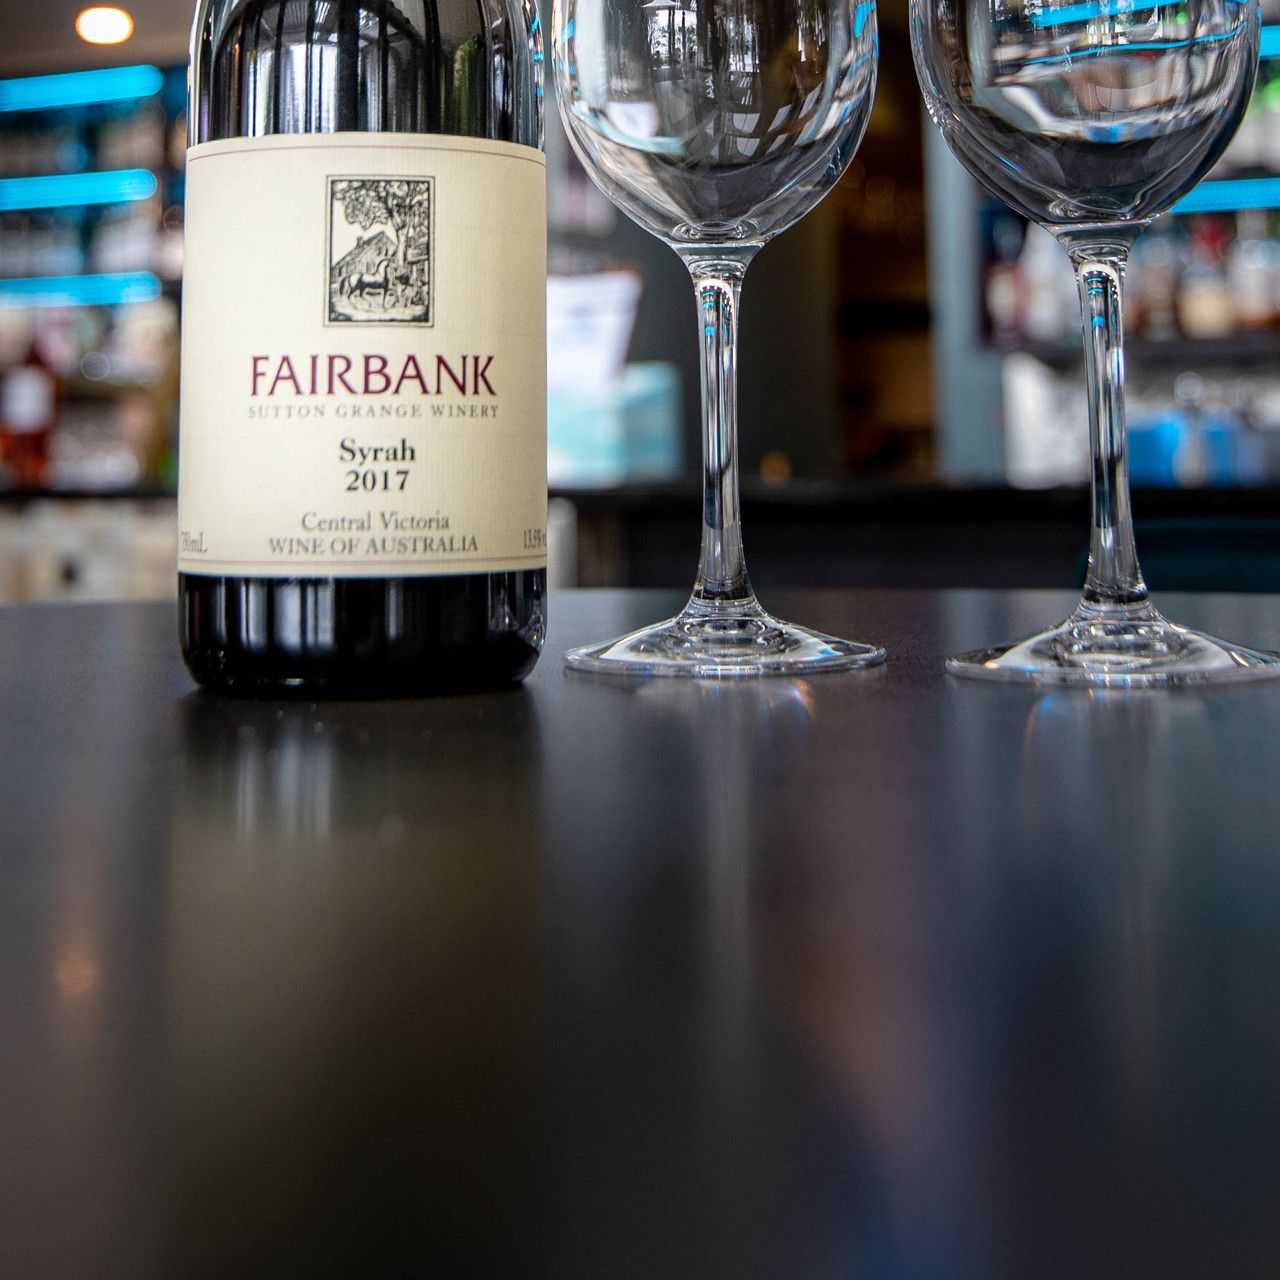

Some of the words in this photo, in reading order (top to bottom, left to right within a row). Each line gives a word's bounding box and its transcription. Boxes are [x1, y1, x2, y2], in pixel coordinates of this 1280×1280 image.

[250, 354, 498, 396] FAIRBANK
[248, 404, 325, 419] SUTTON
[335, 404, 422, 419] GRANGE
[431, 404, 499, 418] WINERY
[339, 437, 417, 465] Syrah
[346, 470, 411, 492] 2017
[301, 510, 371, 531] Central
[380, 510, 450, 530] Victoria
[269, 537, 326, 555] WINE
[330, 537, 362, 555] OF
[366, 535, 479, 554] AUSTRALIA
